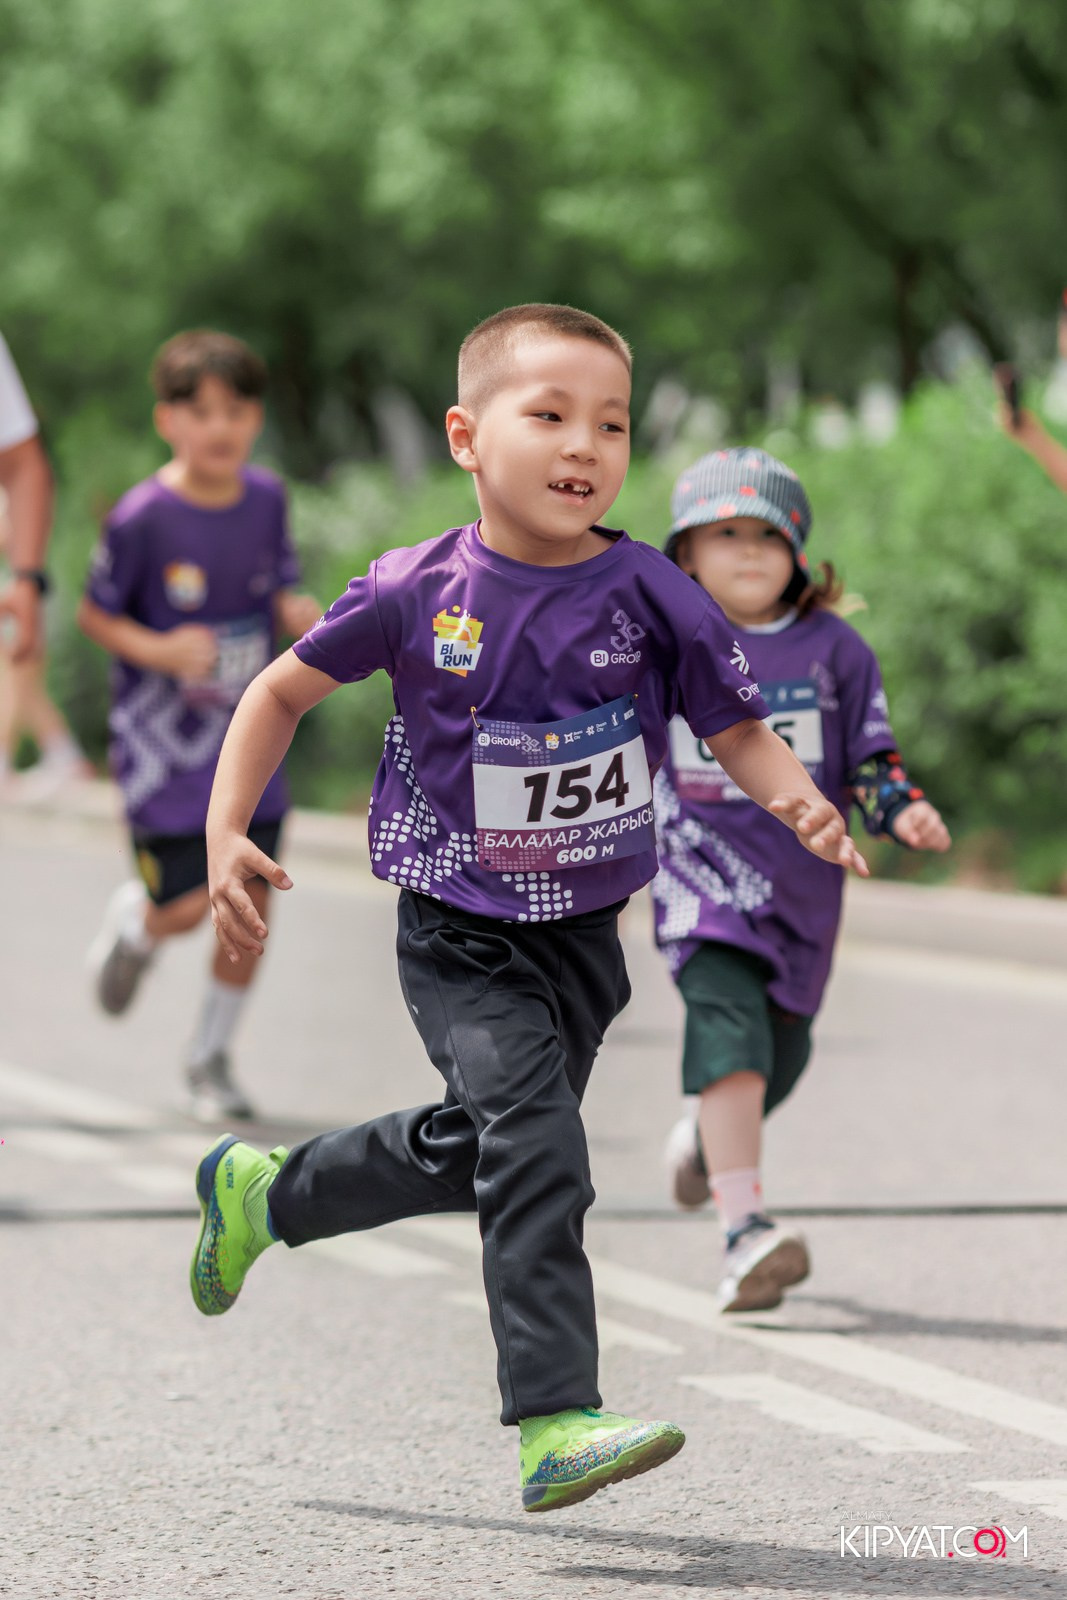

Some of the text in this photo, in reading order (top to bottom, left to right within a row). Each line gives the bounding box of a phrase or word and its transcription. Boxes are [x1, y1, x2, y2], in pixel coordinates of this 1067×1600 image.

[440, 643, 454, 656] BI
[442, 654, 473, 667] RUN
[594, 653, 606, 664] BI
[491, 736, 521, 747] GROUP
[524, 751, 630, 822] 154
[483, 830, 582, 848] БАЛАЛАР
[556, 847, 597, 864] 600
